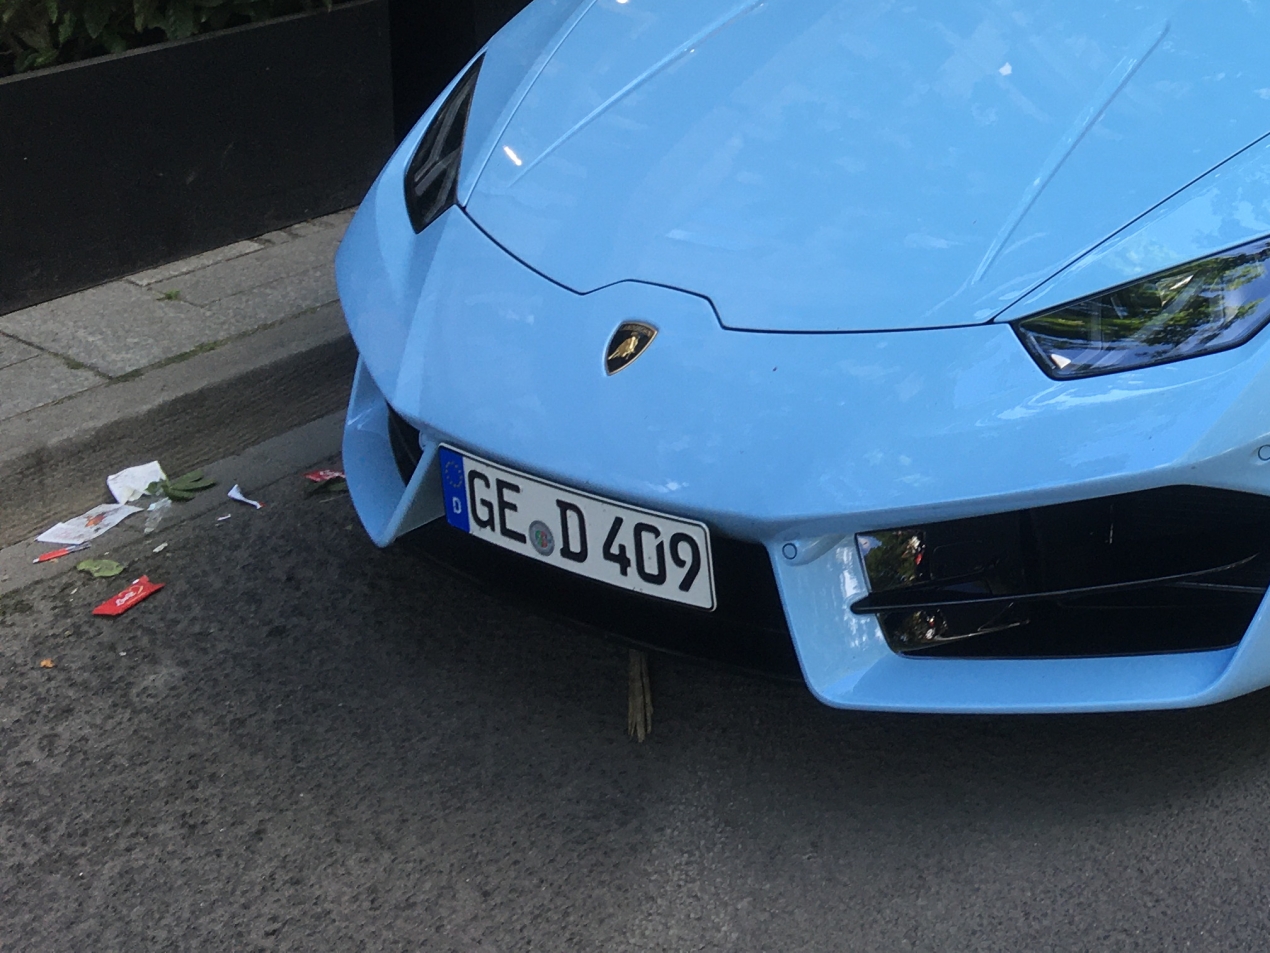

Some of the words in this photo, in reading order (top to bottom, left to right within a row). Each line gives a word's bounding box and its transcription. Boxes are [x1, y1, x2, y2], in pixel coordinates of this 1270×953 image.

[452, 496, 462, 515] D
[467, 469, 527, 545] GE
[555, 498, 589, 564] D
[602, 516, 702, 593] 409
